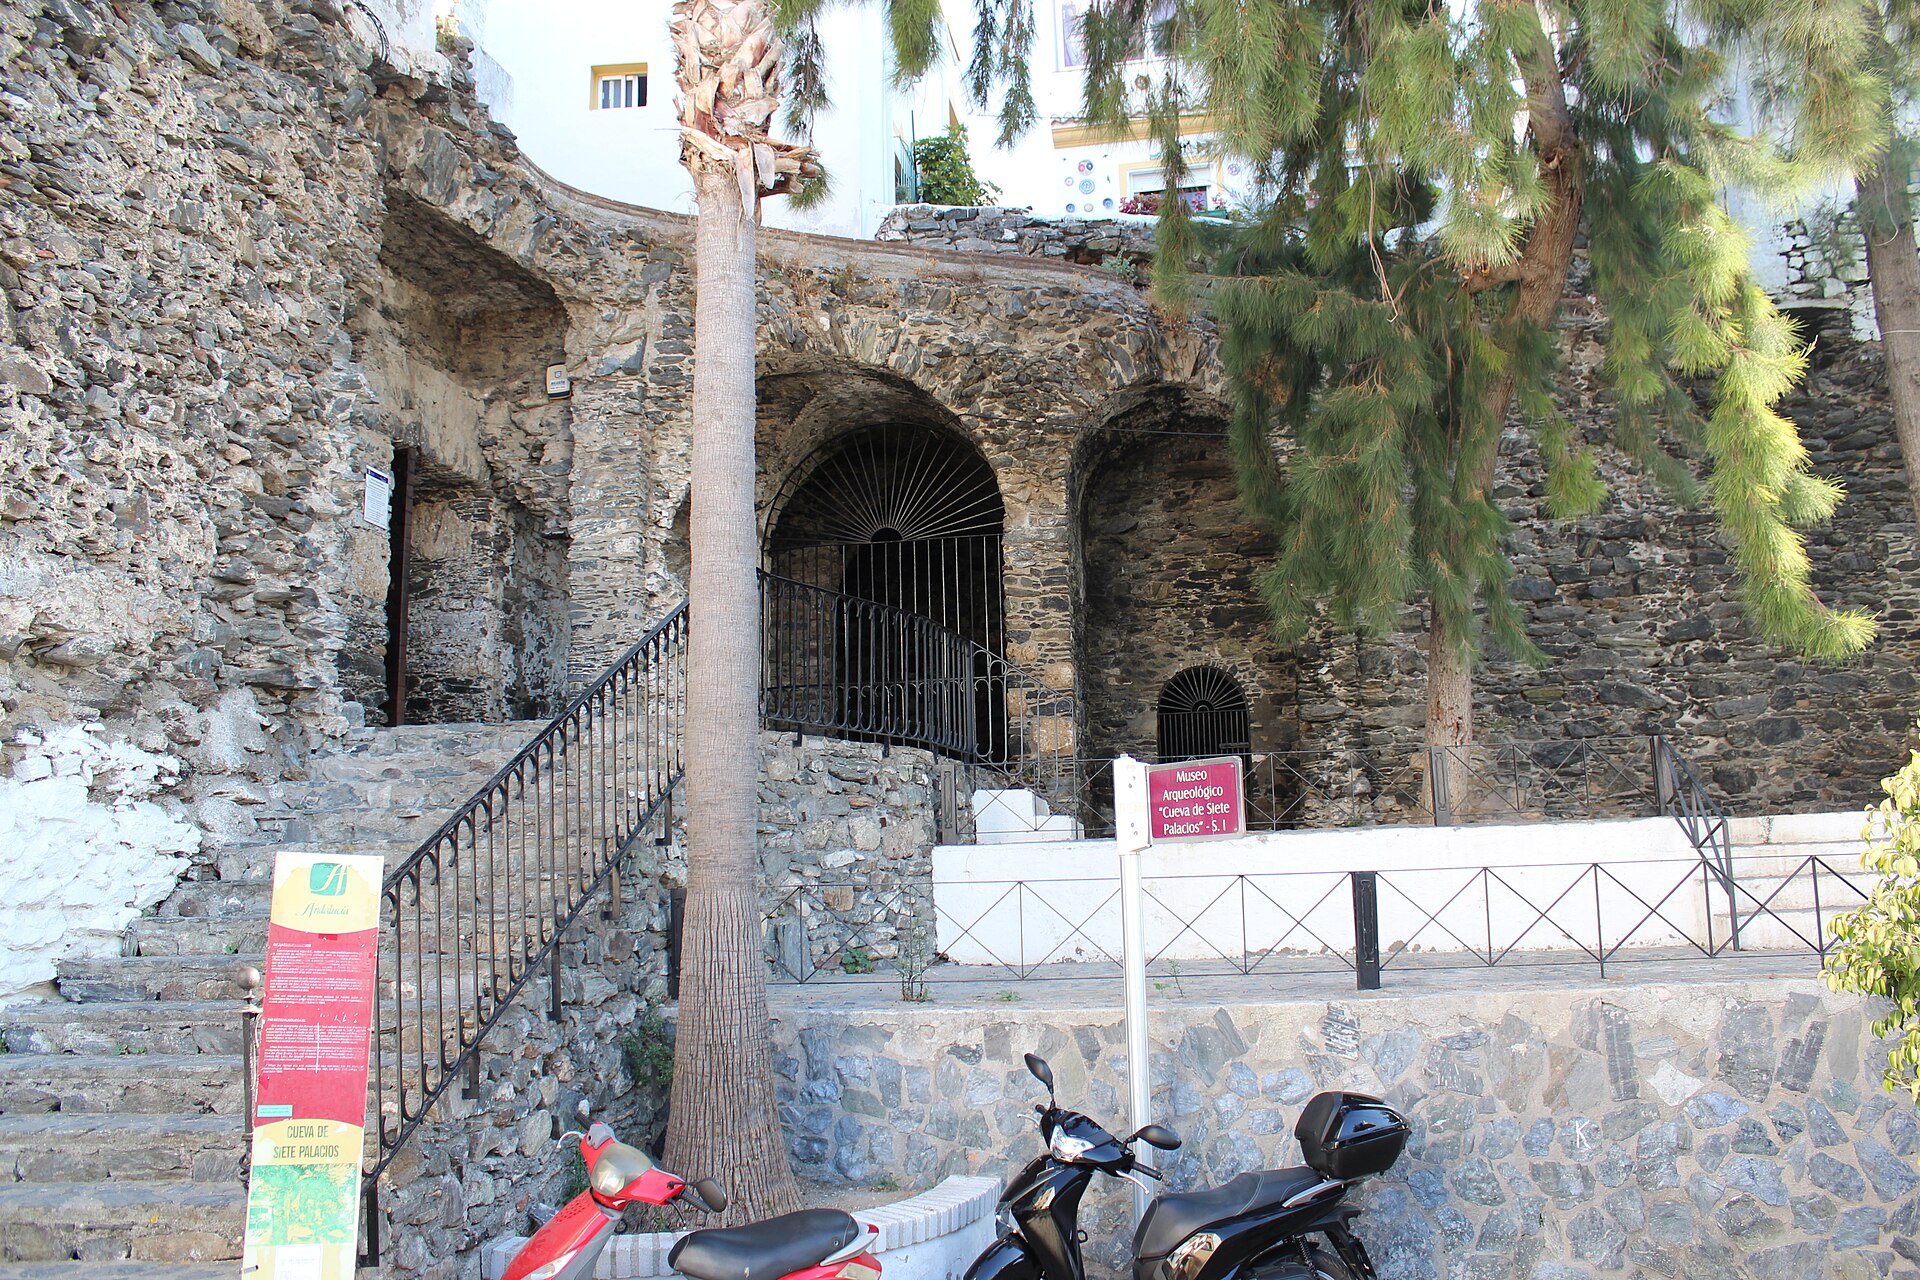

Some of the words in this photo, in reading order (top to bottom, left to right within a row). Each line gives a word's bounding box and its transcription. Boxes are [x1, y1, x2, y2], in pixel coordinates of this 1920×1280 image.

[1176, 770, 1207, 782] Museo
[1162, 785, 1223, 802] Arqueológico
[1158, 805, 1191, 818] "Cueva
[1192, 803, 1204, 816] de
[1207, 802, 1230, 815] Siete
[1163, 821, 1204, 835] Palacios"
[1211, 820, 1220, 832] S.
[295, 902, 349, 918] Andalucía
[287, 1125, 314, 1139] CUEVA
[317, 1125, 329, 1138] DE
[1575, 1119, 1592, 1149] K
[273, 1145, 296, 1158] SIETE
[298, 1145, 339, 1158] PALACIOS
